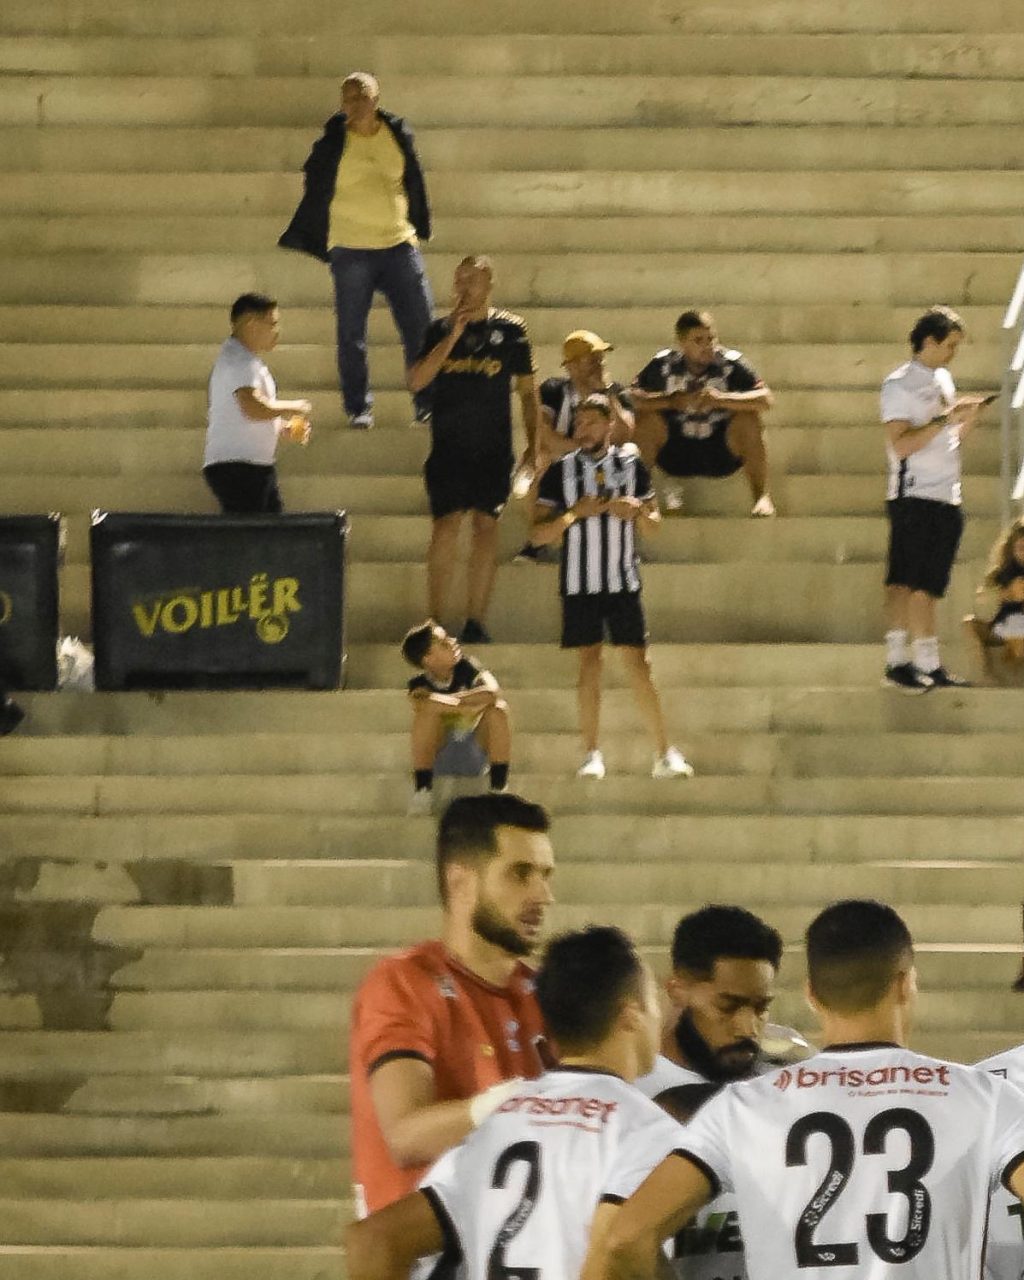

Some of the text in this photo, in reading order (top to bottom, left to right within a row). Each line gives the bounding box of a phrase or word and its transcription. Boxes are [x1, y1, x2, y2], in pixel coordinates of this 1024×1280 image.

[797, 1064, 950, 1089] brisanet
[785, 1107, 935, 1268] 23
[910, 1189, 925, 1231] Sicredi
